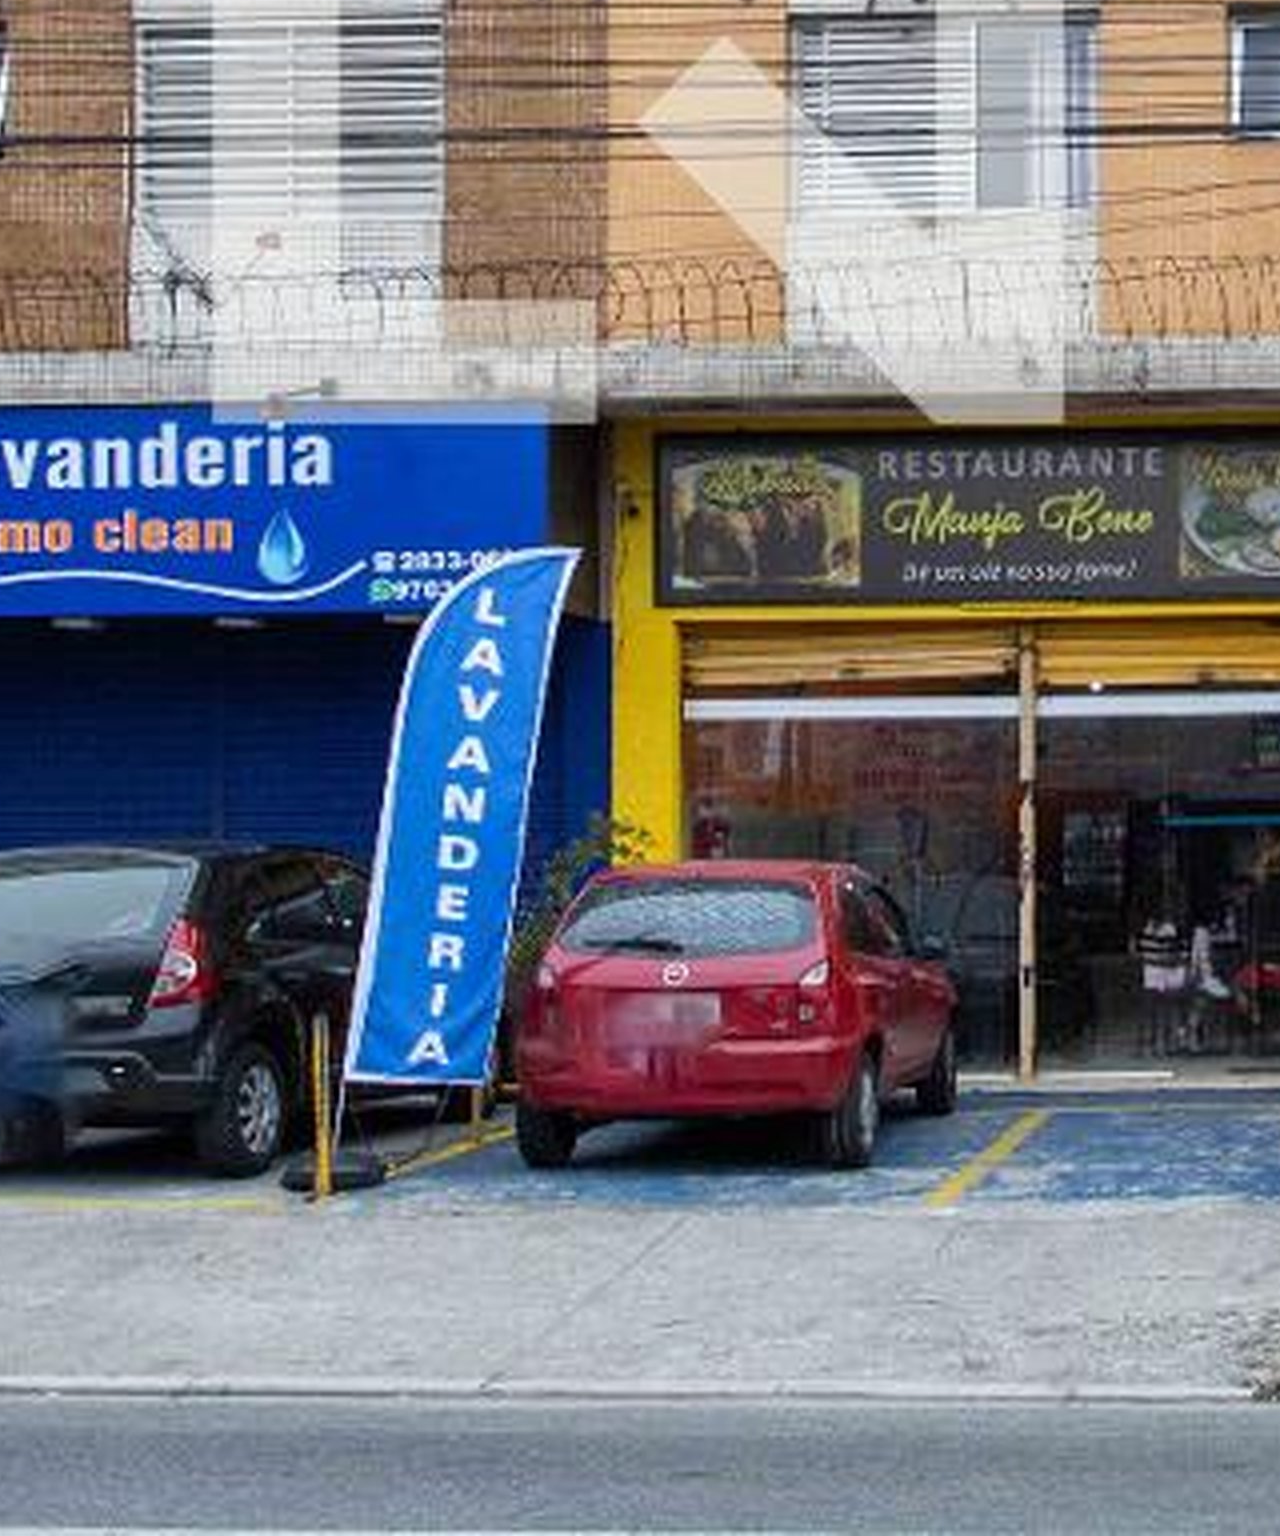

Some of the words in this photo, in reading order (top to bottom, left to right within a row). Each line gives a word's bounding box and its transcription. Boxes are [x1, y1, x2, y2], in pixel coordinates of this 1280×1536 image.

[878, 447, 1163, 479] RESTAURANTE
[94, 509, 234, 553] clean
[883, 491, 1025, 550] Manja
[1039, 486, 1154, 543] Bene
[406, 588, 506, 1065] LAVANDERIA
